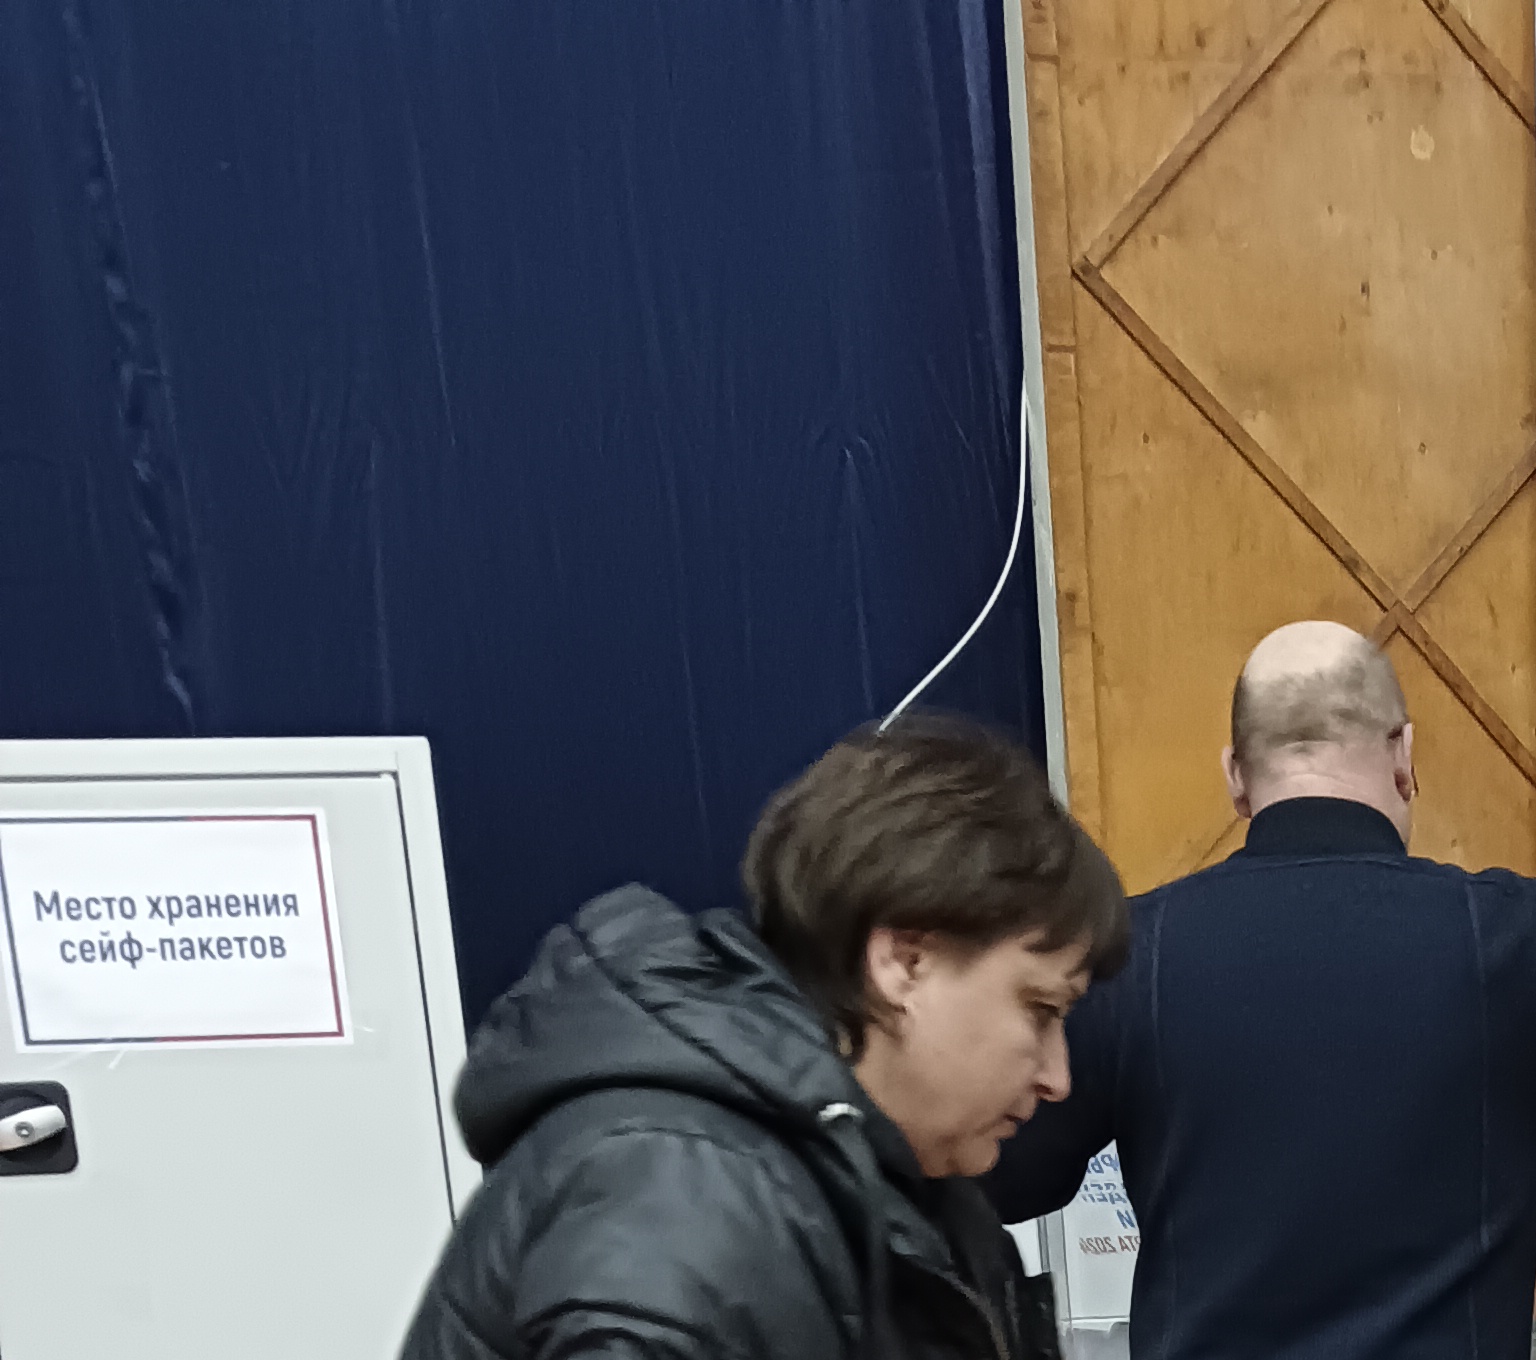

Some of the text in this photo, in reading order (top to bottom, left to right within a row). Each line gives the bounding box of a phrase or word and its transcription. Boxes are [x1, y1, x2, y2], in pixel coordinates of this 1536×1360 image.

[33, 890, 300, 926] Место хранения
[59, 931, 287, 969] сейф-пакетов
